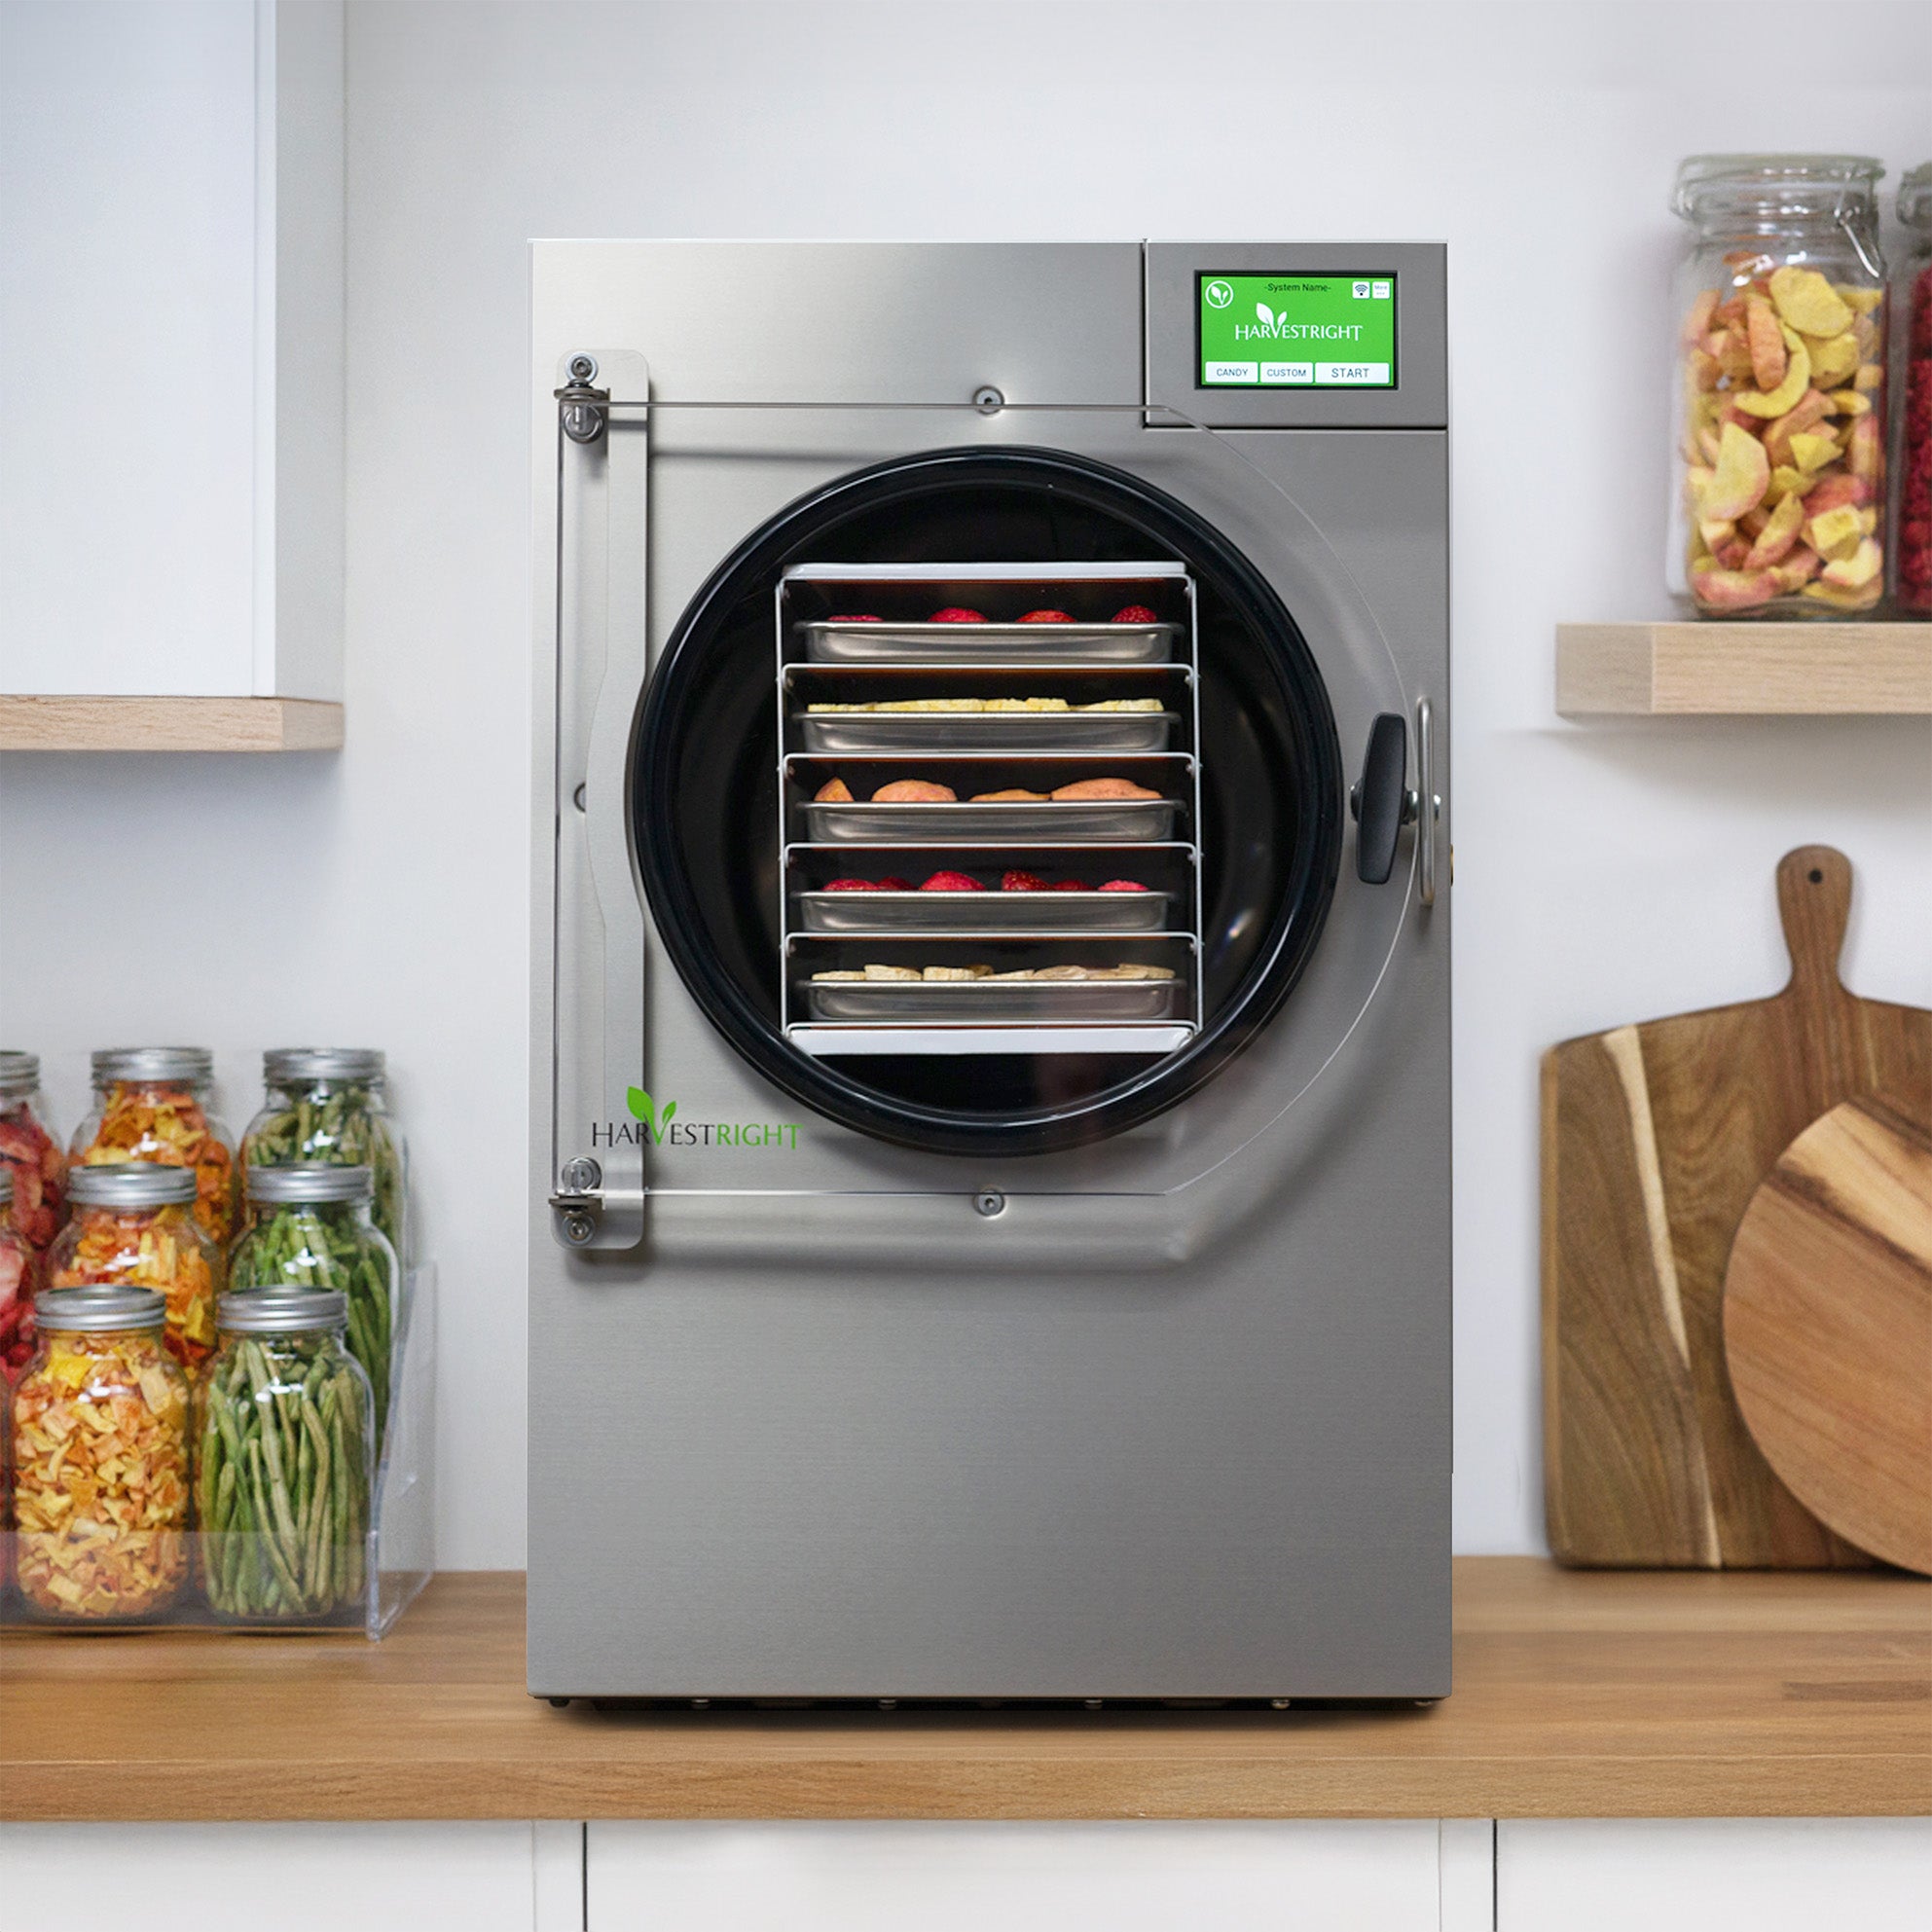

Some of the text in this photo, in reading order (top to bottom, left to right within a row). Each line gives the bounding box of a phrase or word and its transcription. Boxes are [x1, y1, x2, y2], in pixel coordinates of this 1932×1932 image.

[1234, 314, 1364, 342] HARVESTRIGHT
[1216, 368, 1249, 377] CANDY
[1331, 368, 1369, 378] START
[592, 1103, 804, 1149] HARVESTRIGHT
